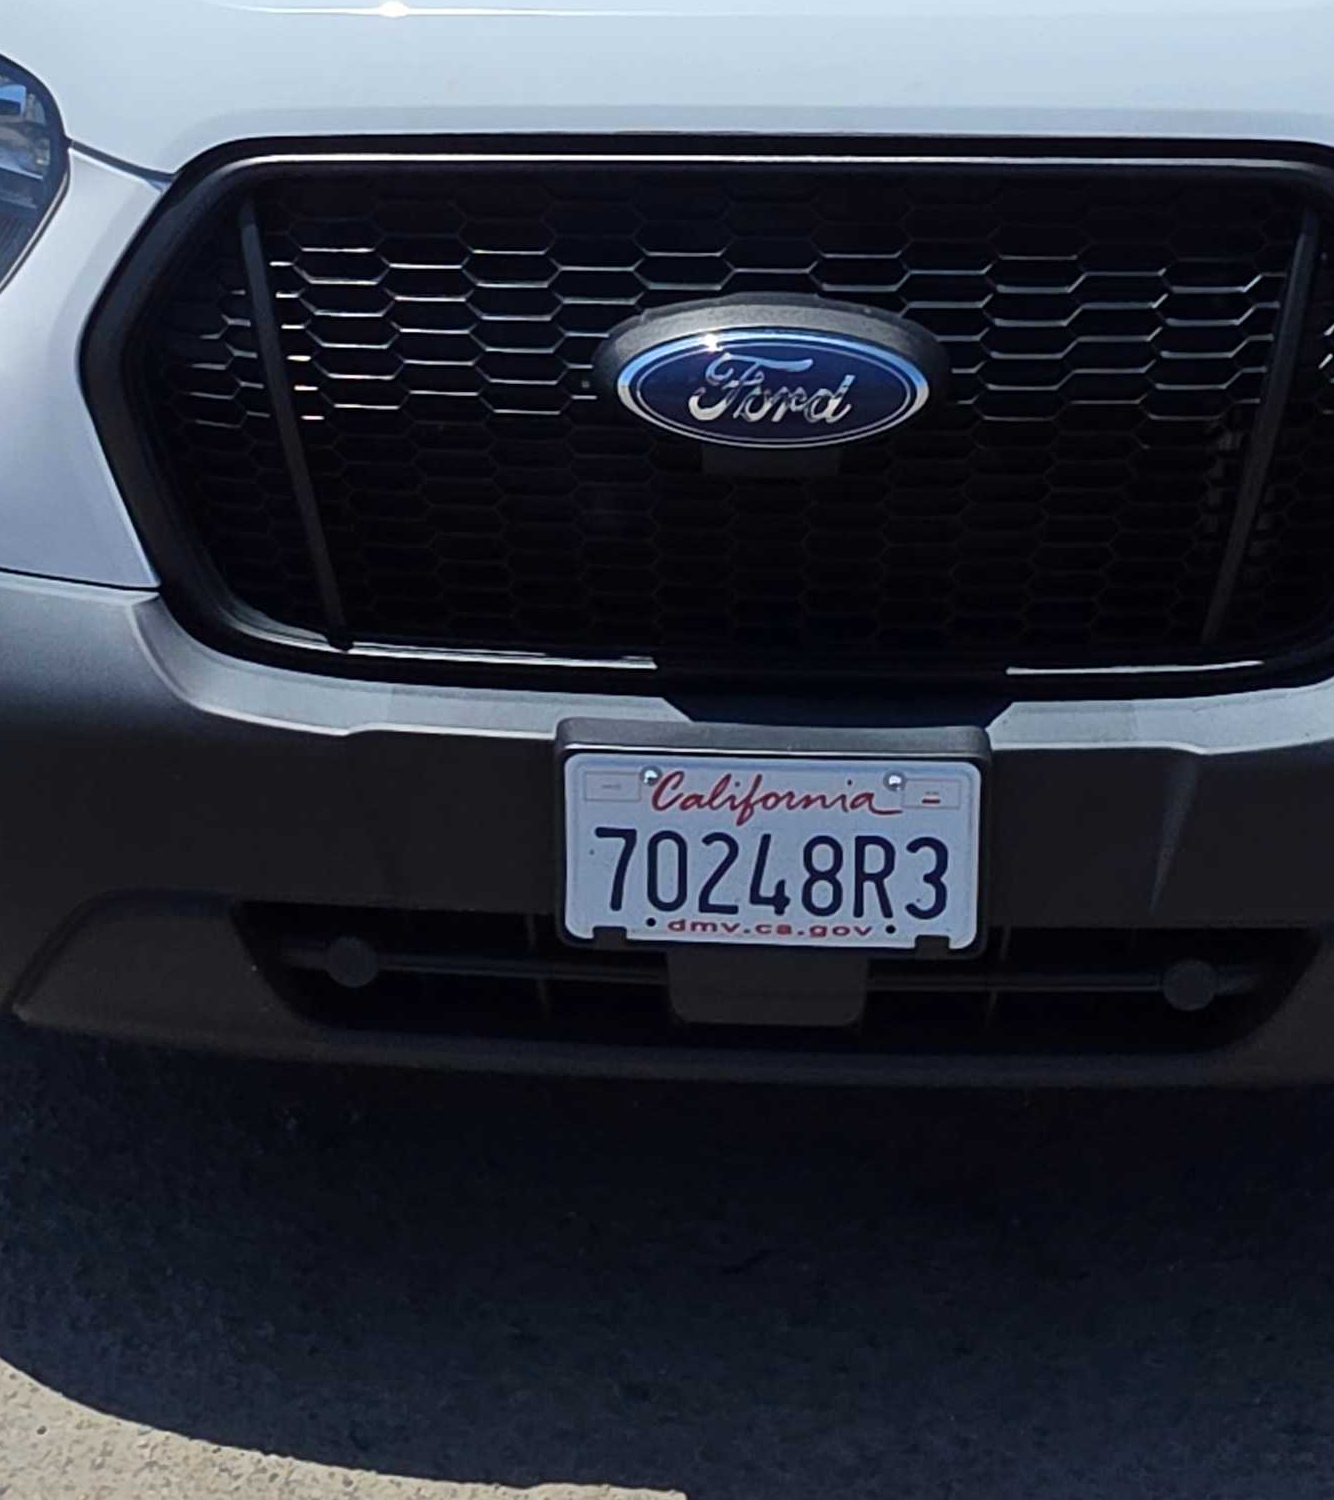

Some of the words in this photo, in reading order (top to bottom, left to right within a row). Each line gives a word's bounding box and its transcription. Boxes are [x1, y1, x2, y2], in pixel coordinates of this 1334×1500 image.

[688, 352, 856, 424] Ford
[651, 770, 903, 827] California
[594, 826, 950, 920] 70248R3
[667, 918, 873, 937] dmv.ca.gov
